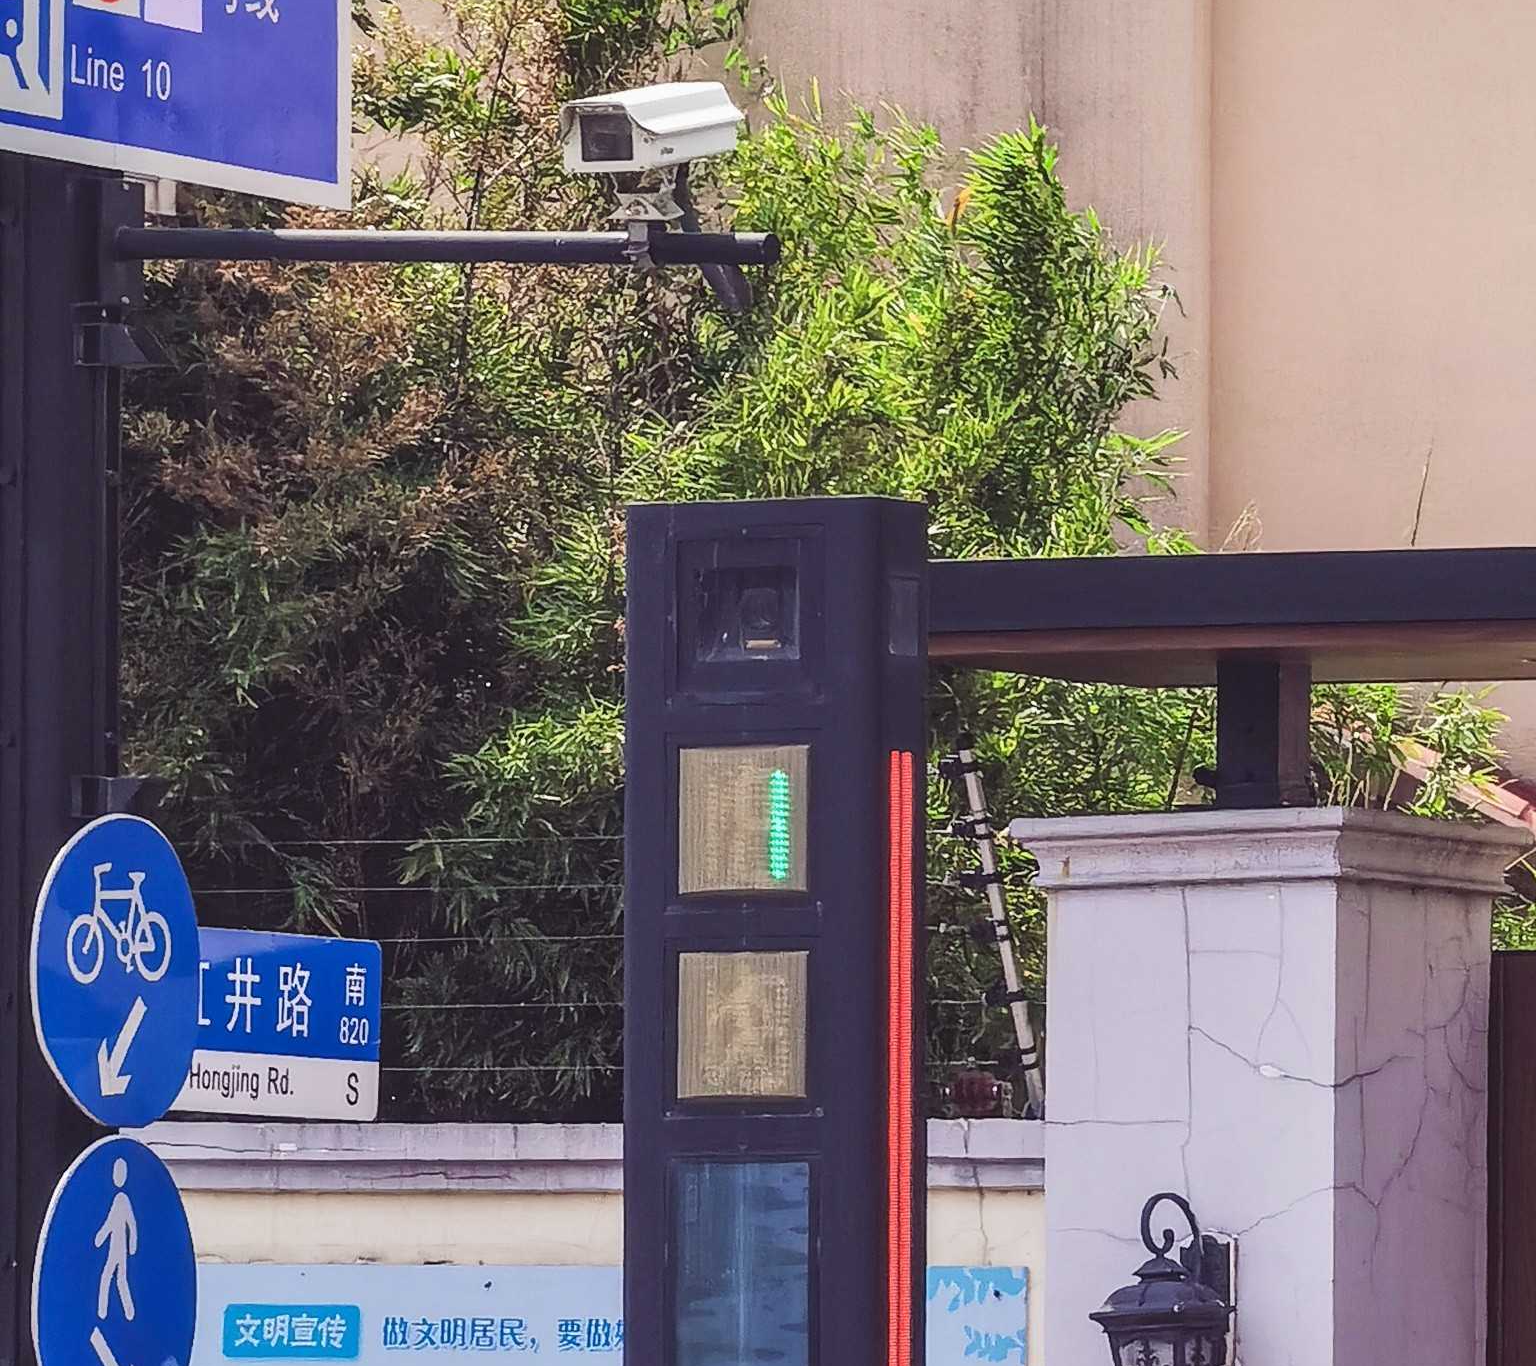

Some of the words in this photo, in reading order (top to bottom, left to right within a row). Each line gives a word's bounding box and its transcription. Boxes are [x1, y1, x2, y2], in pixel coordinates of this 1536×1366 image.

[70, 43, 125, 92] Line
[141, 58, 172, 101] 10
[345, 962, 367, 1007] 南
[339, 1016, 369, 1046] 820
[190, 1062, 260, 1100] Hongjing
[267, 1066, 294, 1095] Rd.
[345, 1071, 360, 1106] S
[234, 1313, 347, 1348] 文明宣传
